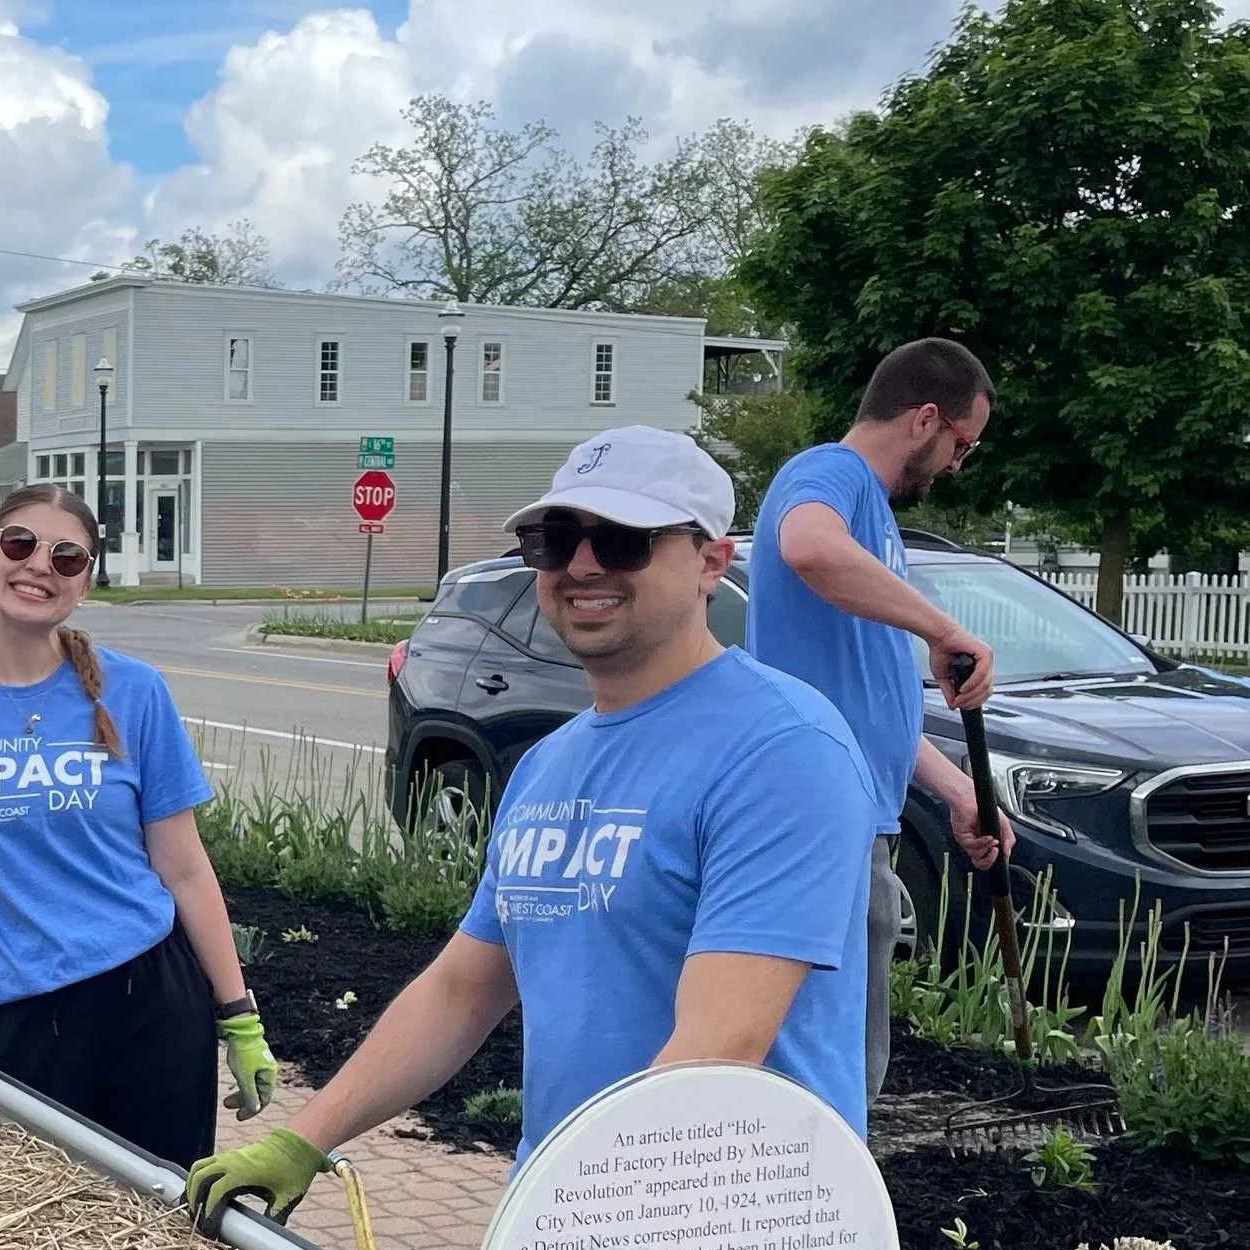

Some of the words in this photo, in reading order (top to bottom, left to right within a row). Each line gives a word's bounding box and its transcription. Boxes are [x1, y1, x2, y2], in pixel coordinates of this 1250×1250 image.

[355, 486, 394, 506] STOP
[49, 789, 98, 810] DAY
[508, 799, 598, 826] COMMUNITY
[509, 901, 534, 914] WEST
[535, 903, 573, 917] COAST
[578, 882, 616, 913] DAY
[614, 1132, 634, 1147] An
[639, 1127, 683, 1145] article
[688, 1122, 723, 1140] titled
[579, 1158, 609, 1176] land
[614, 1156, 668, 1172] Factory
[672, 1146, 722, 1168] Helped
[726, 1145, 746, 1164] By
[751, 1142, 809, 1158] Mexican
[645, 1172, 708, 1198] appeared
[713, 1171, 726, 1187] in
[731, 1169, 751, 1185] the
[756, 1161, 809, 1182] Holland
[535, 1214, 566, 1233] City
[571, 1210, 612, 1227] News
[616, 1209, 634, 1222] on
[638, 1203, 693, 1220] January
[699, 1196, 718, 1213] 10,
[721, 1192, 761, 1210] 1924,
[766, 1188, 812, 1205] written
[817, 1184, 833, 1202] by
[589, 1234, 630, 1250] News
[634, 1221, 736, 1245] correspondent.
[741, 1217, 751, 1232] It
[755, 1209, 811, 1233] reported
[815, 1208, 840, 1223] that
[839, 1229, 858, 1244] for
